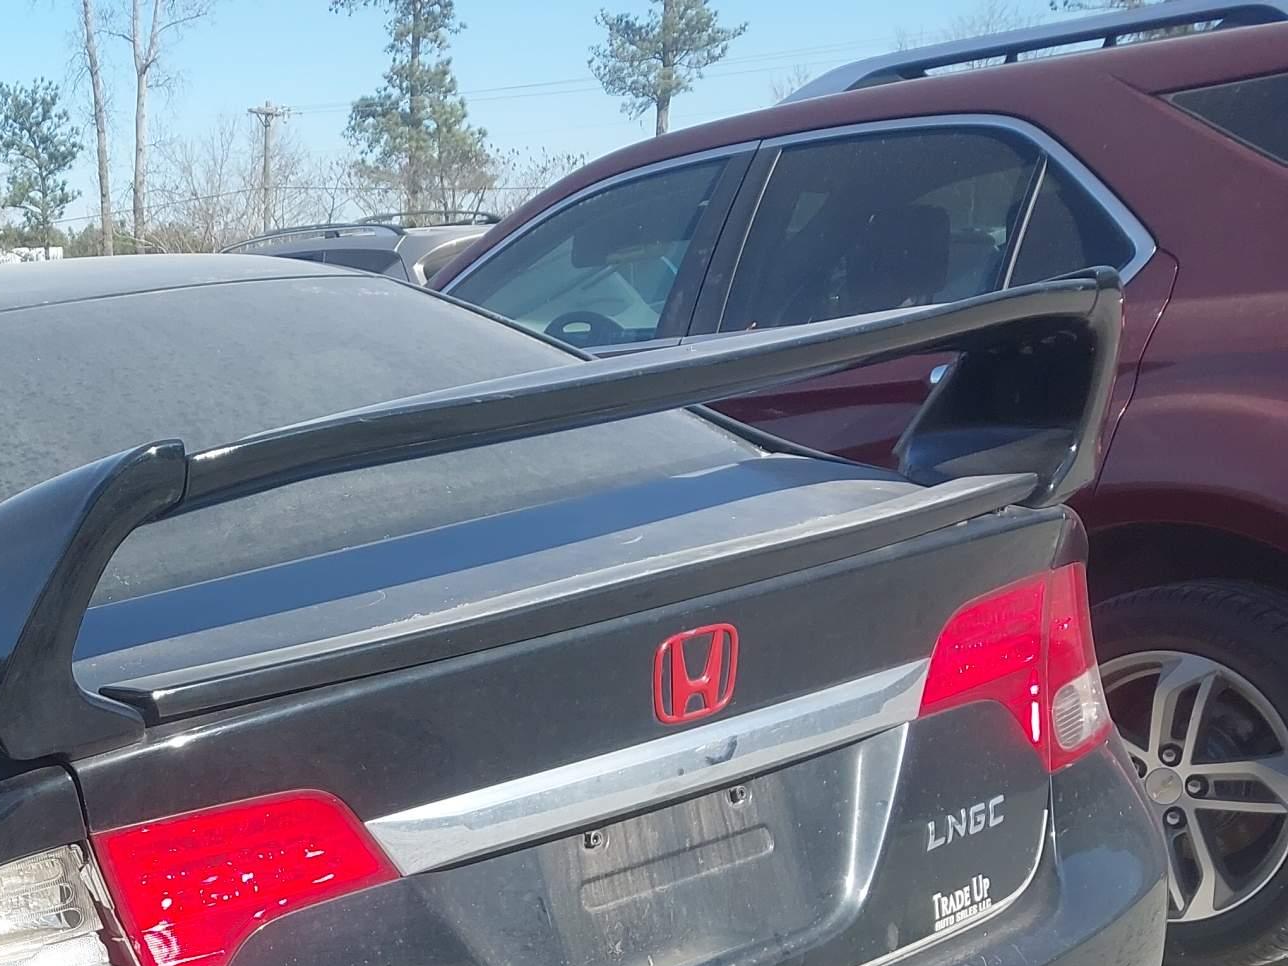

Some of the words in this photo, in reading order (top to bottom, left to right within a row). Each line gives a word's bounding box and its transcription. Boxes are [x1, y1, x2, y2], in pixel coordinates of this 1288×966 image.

[927, 795, 1004, 851] LNGC
[934, 914, 955, 932] AUTO
[955, 904, 978, 922] SALES
